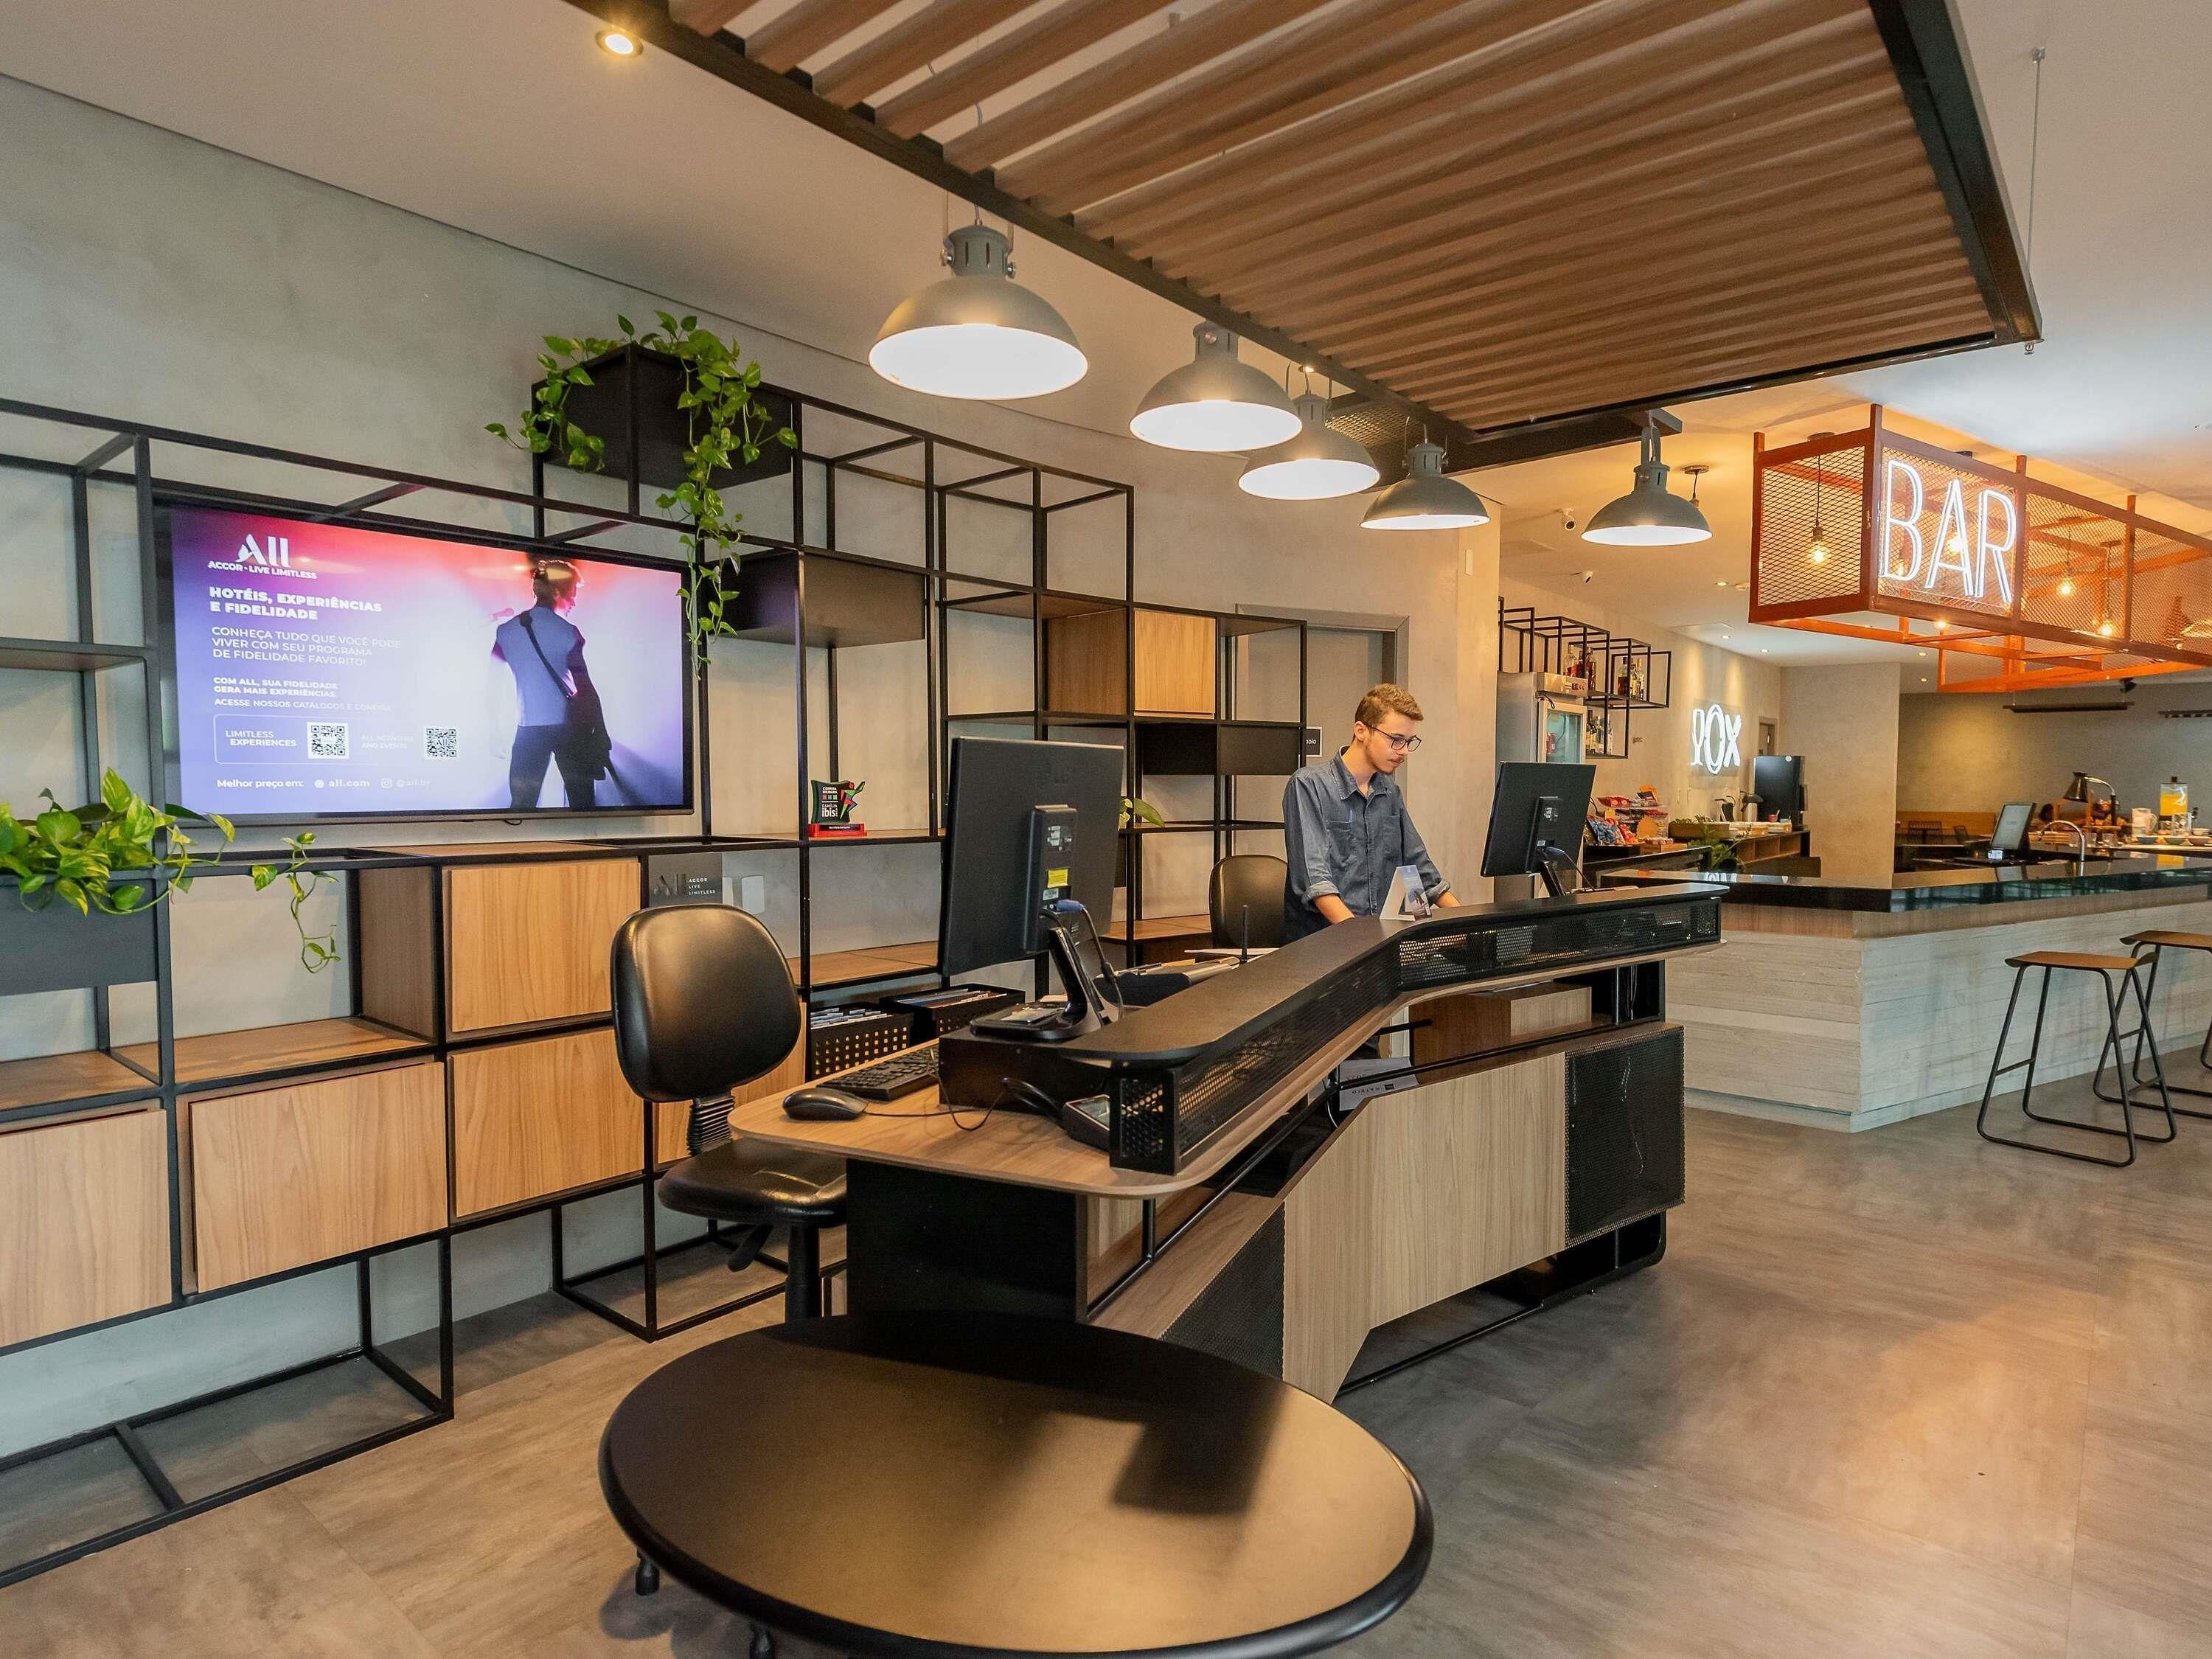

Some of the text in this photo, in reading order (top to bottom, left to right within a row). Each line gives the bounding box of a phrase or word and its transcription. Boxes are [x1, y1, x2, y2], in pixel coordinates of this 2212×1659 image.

[1879, 459, 2017, 602] BAR
[235, 534, 291, 568] All
[207, 560, 318, 580] ACCOR LIVE LIMITLESS
[209, 586, 383, 612] HOTÉIS, EXPERIÊNCIAS
[210, 601, 319, 620] E FIDELIDADE
[212, 627, 273, 640] CONHEÇA
[275, 630, 308, 641] TUDO
[311, 634, 336, 644] QUE
[372, 639, 402, 649] PODE
[212, 638, 372, 655] VIVER COM SEU PROGRAMA
[212, 648, 231, 658] DE
[234, 650, 306, 663] FIDELIDADE
[213, 677, 237, 685] COM
[283, 680, 338, 689] FIDELIDADE
[214, 686, 241, 694] GERA
[215, 698, 251, 706] ACESSE
[253, 700, 291, 708] NOSSOS
[225, 730, 274, 738] LIMITLESS
[230, 738, 296, 747] EXPERIENCES
[217, 779, 252, 787] Melhor
[255, 779, 284, 790] preço
[285, 779, 304, 787] em:
[328, 779, 370, 787] all.com
[821, 807, 836, 818] ibis
